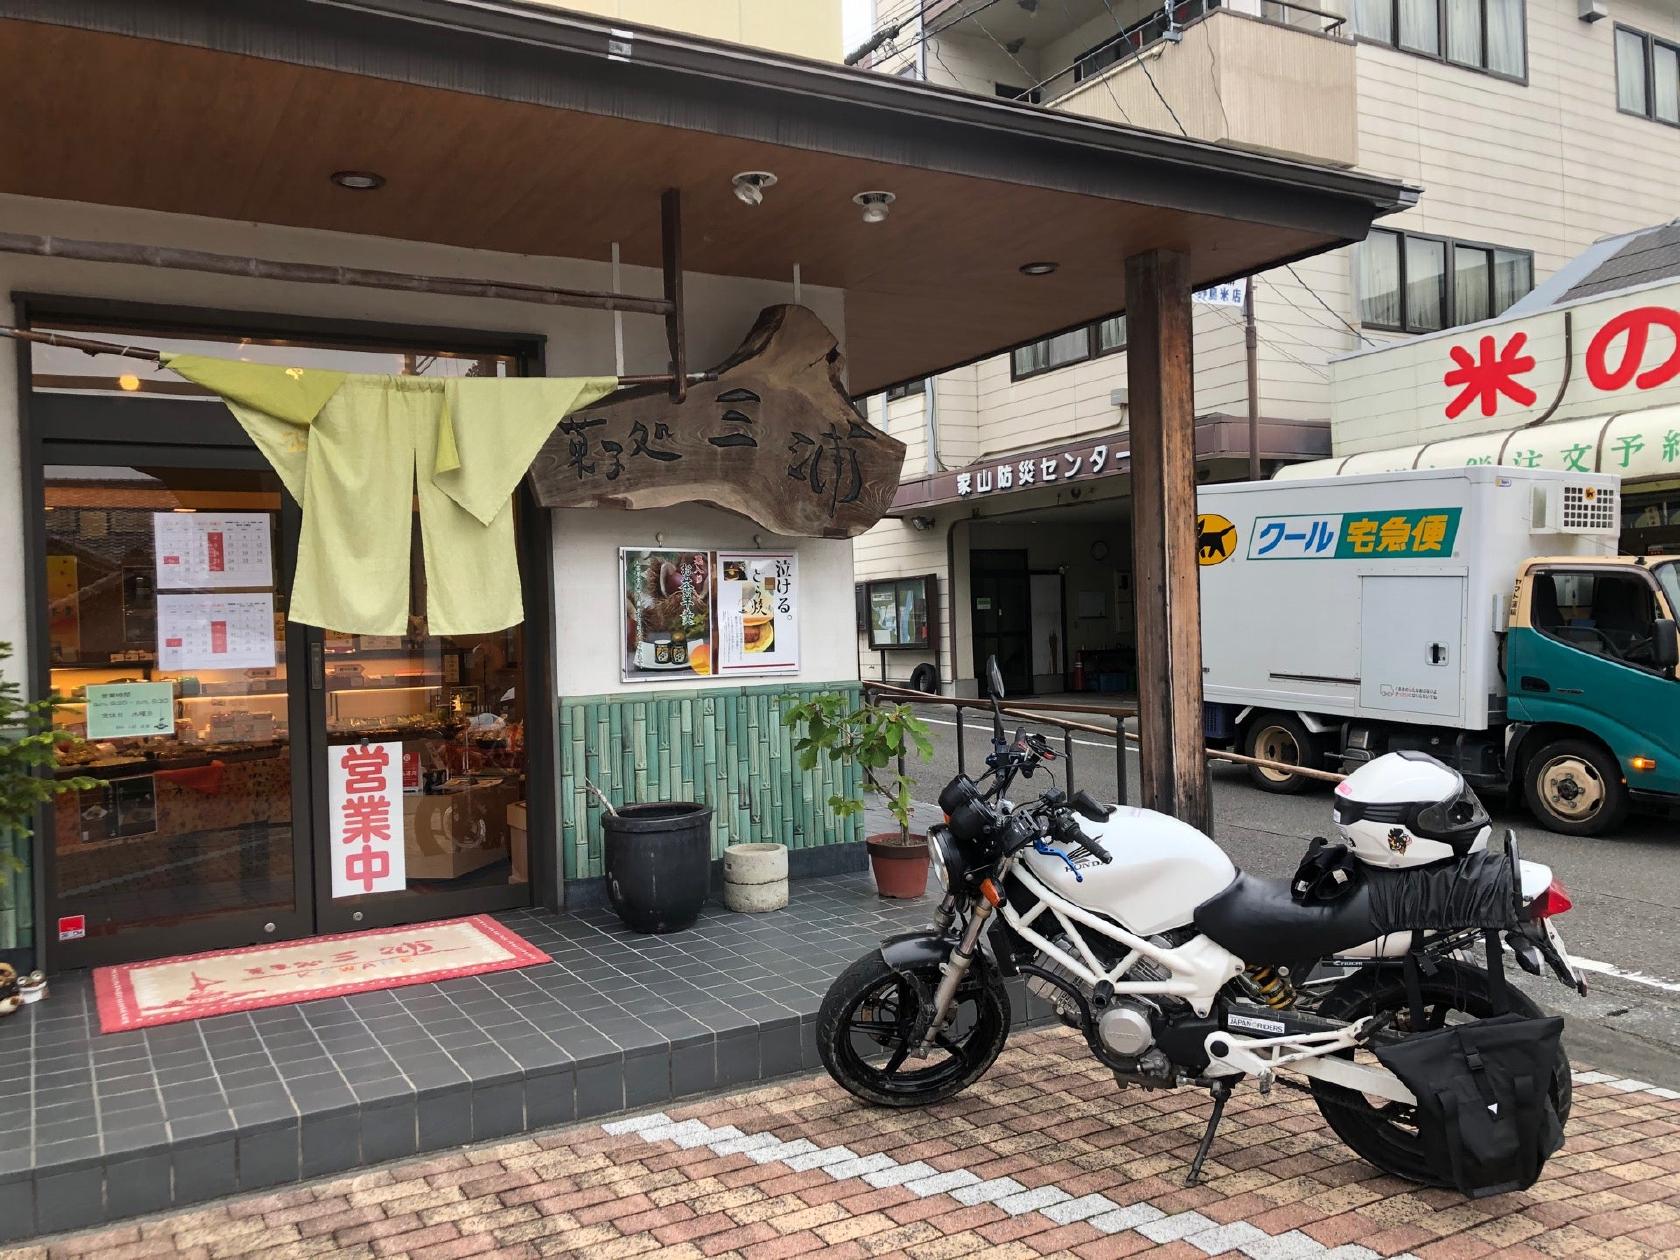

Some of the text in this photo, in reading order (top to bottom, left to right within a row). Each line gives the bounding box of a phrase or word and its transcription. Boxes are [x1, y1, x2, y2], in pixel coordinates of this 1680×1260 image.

[1444, 306, 1680, 420] 米の
[341, 745, 391, 892] 営業中
[1065, 860, 1104, 872] HOND
